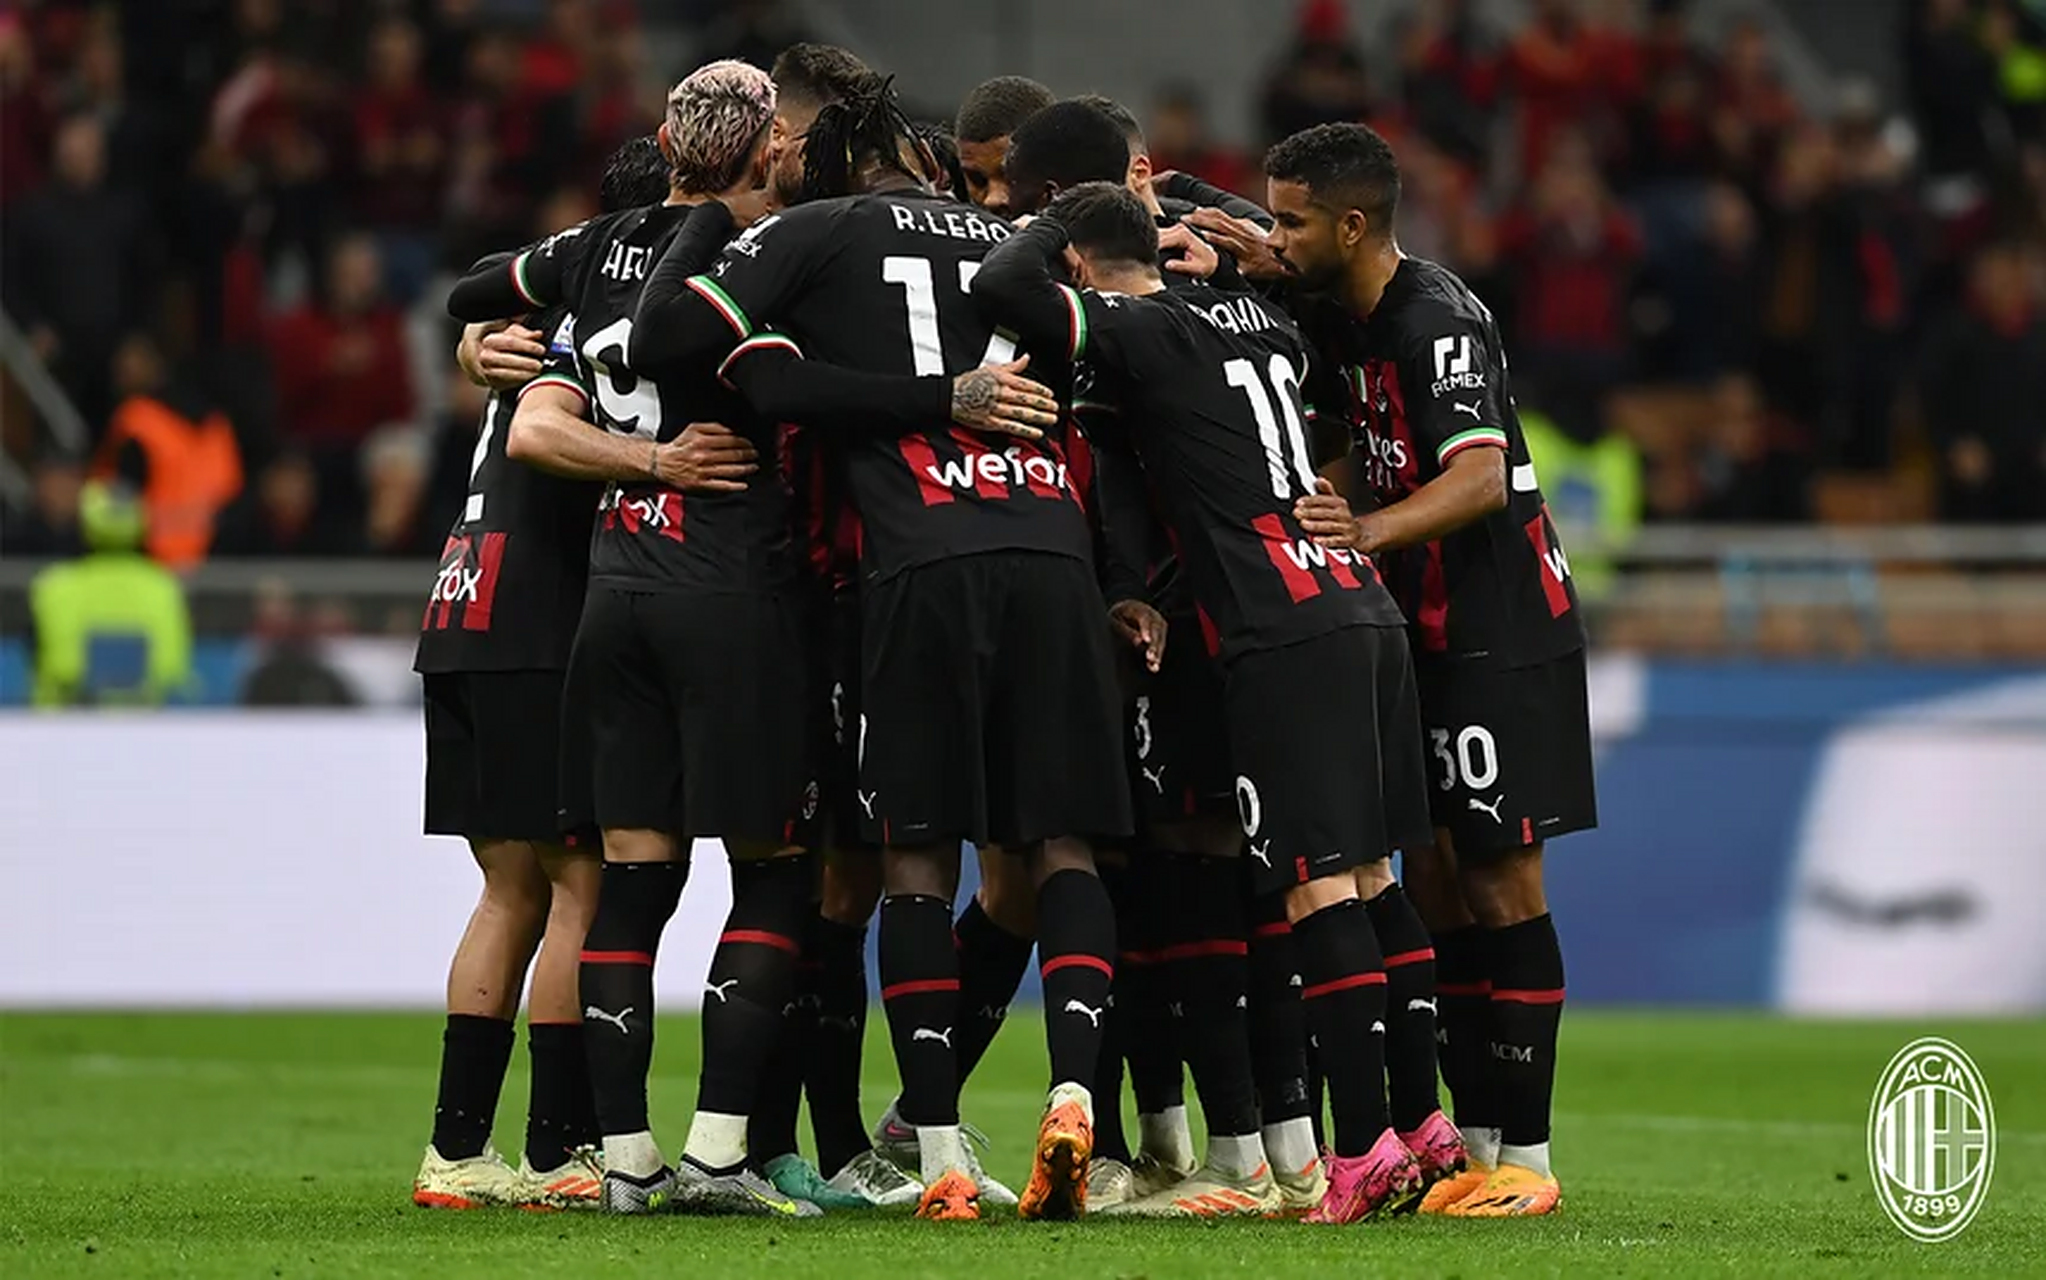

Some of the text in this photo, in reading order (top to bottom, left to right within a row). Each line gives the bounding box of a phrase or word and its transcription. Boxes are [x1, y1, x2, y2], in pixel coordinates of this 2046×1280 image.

[1430, 373, 1486, 398] BtMEX
[1223, 354, 1318, 498] 10
[432, 558, 483, 602] fox
[1430, 725, 1498, 790] 30
